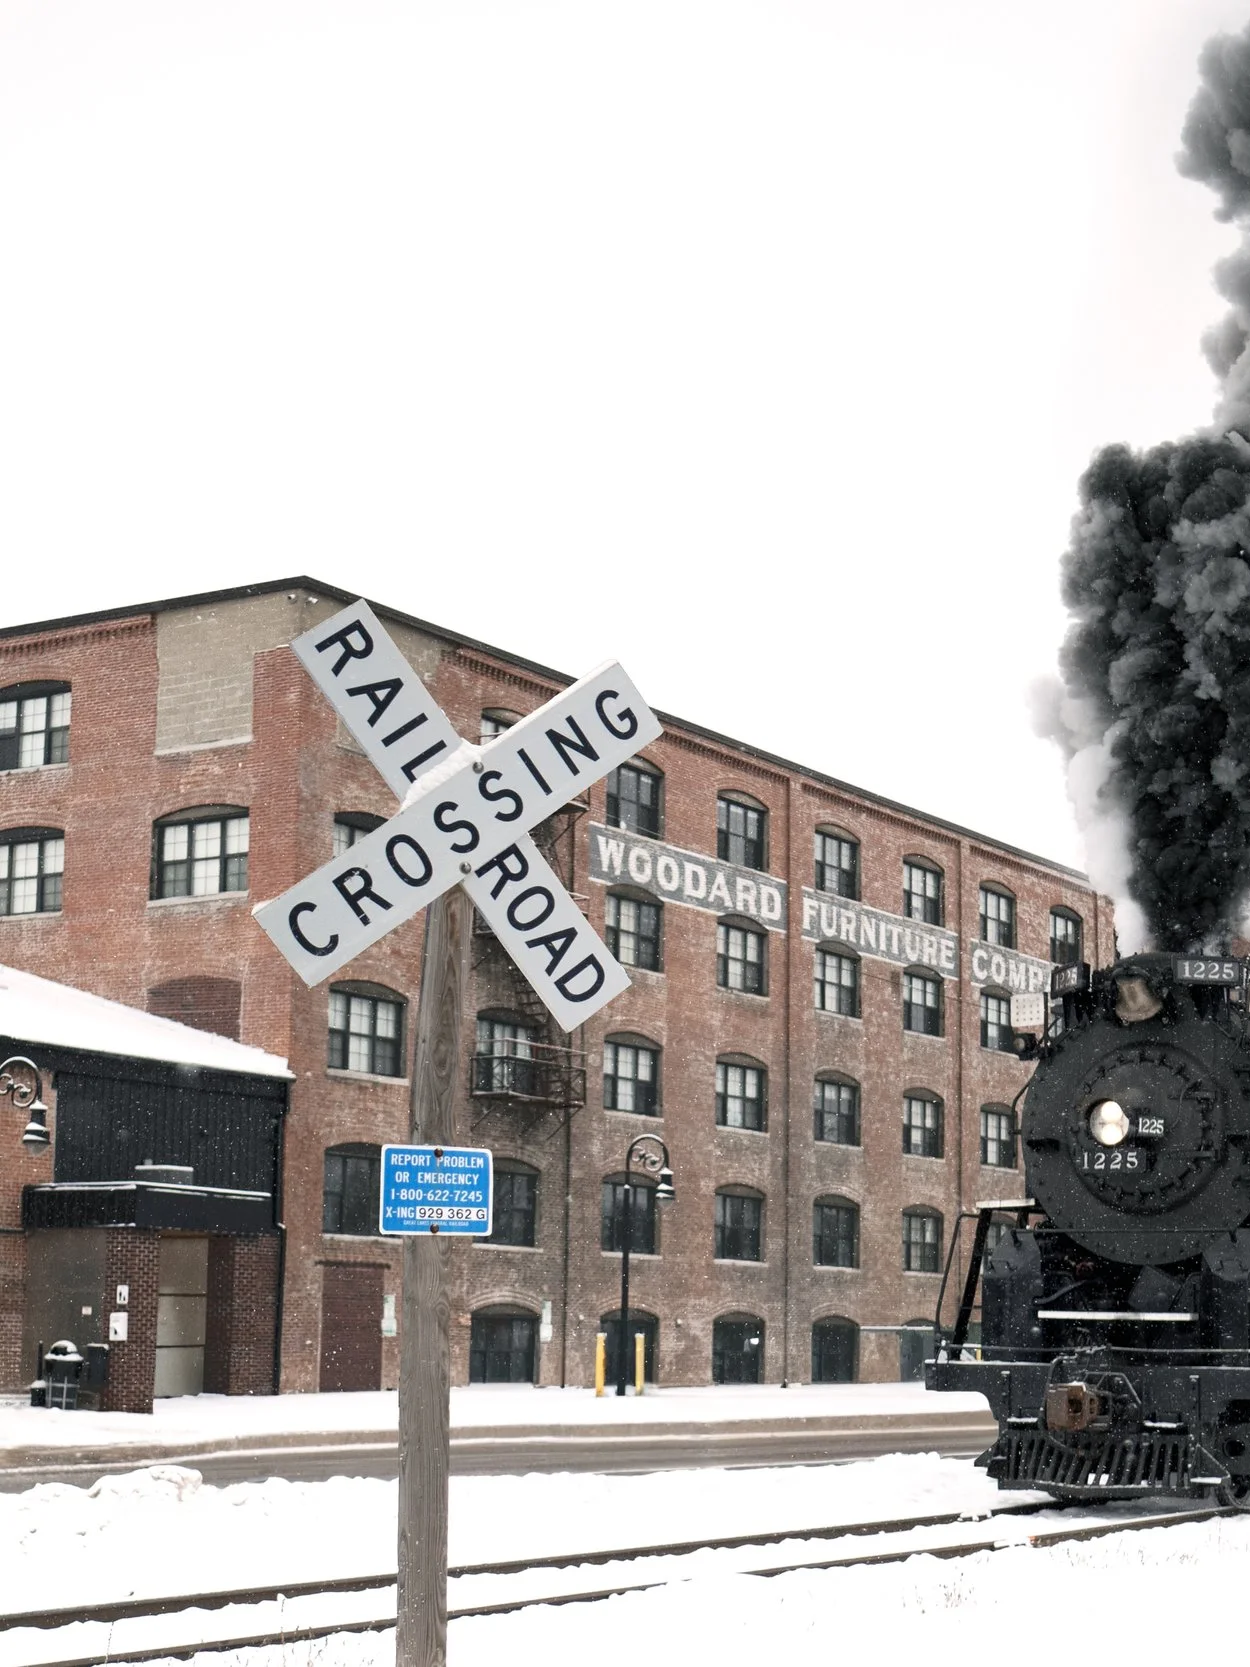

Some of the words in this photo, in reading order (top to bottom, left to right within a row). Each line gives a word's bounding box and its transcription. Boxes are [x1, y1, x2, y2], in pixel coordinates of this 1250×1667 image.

[315, 618, 447, 785] RAIL
[288, 689, 638, 957] CROSSING
[597, 835, 782, 921] WOODARD
[803, 897, 955, 970] FURNITURE
[475, 843, 605, 1003] ROAD
[1056, 967, 1078, 990] 1225
[1183, 961, 1234, 979] 1225
[1138, 1117, 1164, 1134] 1225
[391, 1154, 431, 1166] REPORT
[437, 1156, 484, 1168] PROBLEM
[1082, 1152, 1138, 1169] 1225
[395, 1172, 409, 1183] OR
[417, 1172, 479, 1185] EMERGENCY
[391, 1188, 483, 1202] 1-800-622-7245
[385, 1206, 415, 1218] X-ING
[419, 1208, 443, 1218] 929
[448, 1208, 472, 1219] 362
[476, 1209, 485, 1219] G
